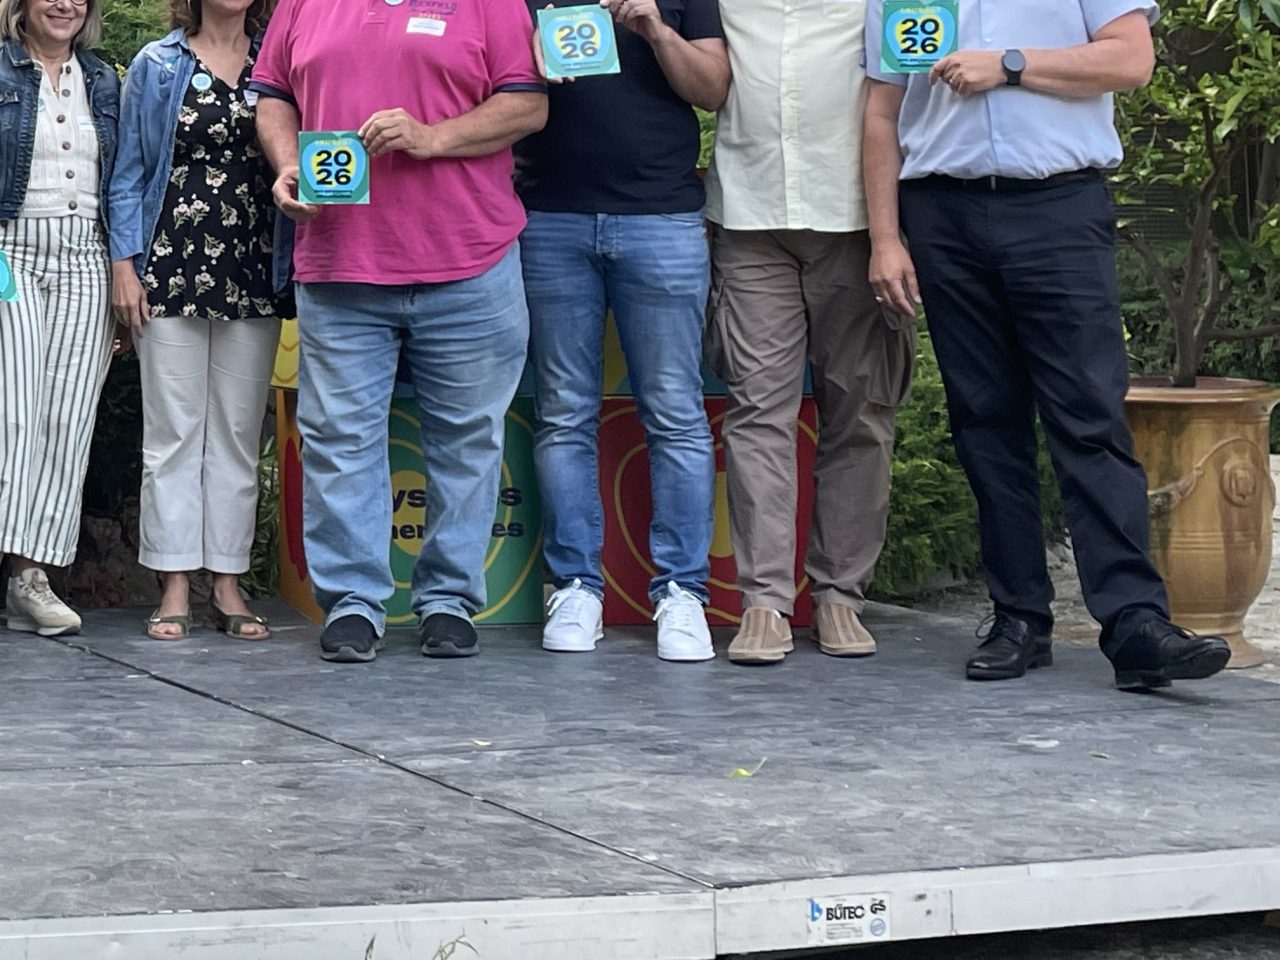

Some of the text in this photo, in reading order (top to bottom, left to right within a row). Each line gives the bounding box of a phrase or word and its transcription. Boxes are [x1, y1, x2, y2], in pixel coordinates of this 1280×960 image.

[558, 23, 596, 42] 20
[900, 18, 940, 36] 20
[560, 41, 598, 59] 26
[900, 37, 939, 54] 26
[315, 150, 352, 167] 20
[315, 168, 352, 186] 26
